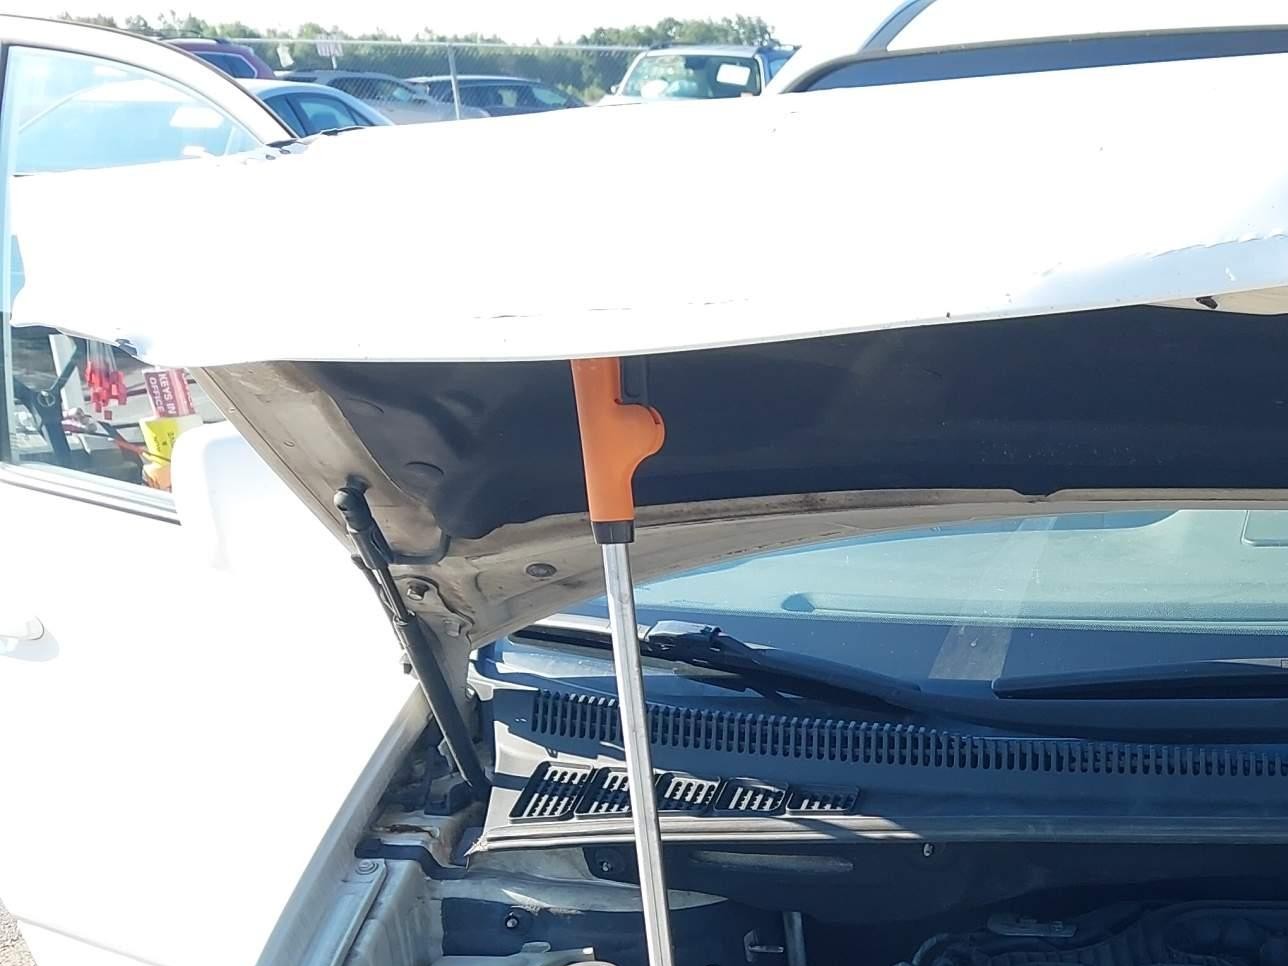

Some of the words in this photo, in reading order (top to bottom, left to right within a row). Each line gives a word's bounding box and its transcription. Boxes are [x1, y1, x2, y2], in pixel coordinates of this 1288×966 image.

[149, 376, 165, 412] OFFICE
[158, 373, 174, 401] KEYS
[166, 402, 177, 414] IN
